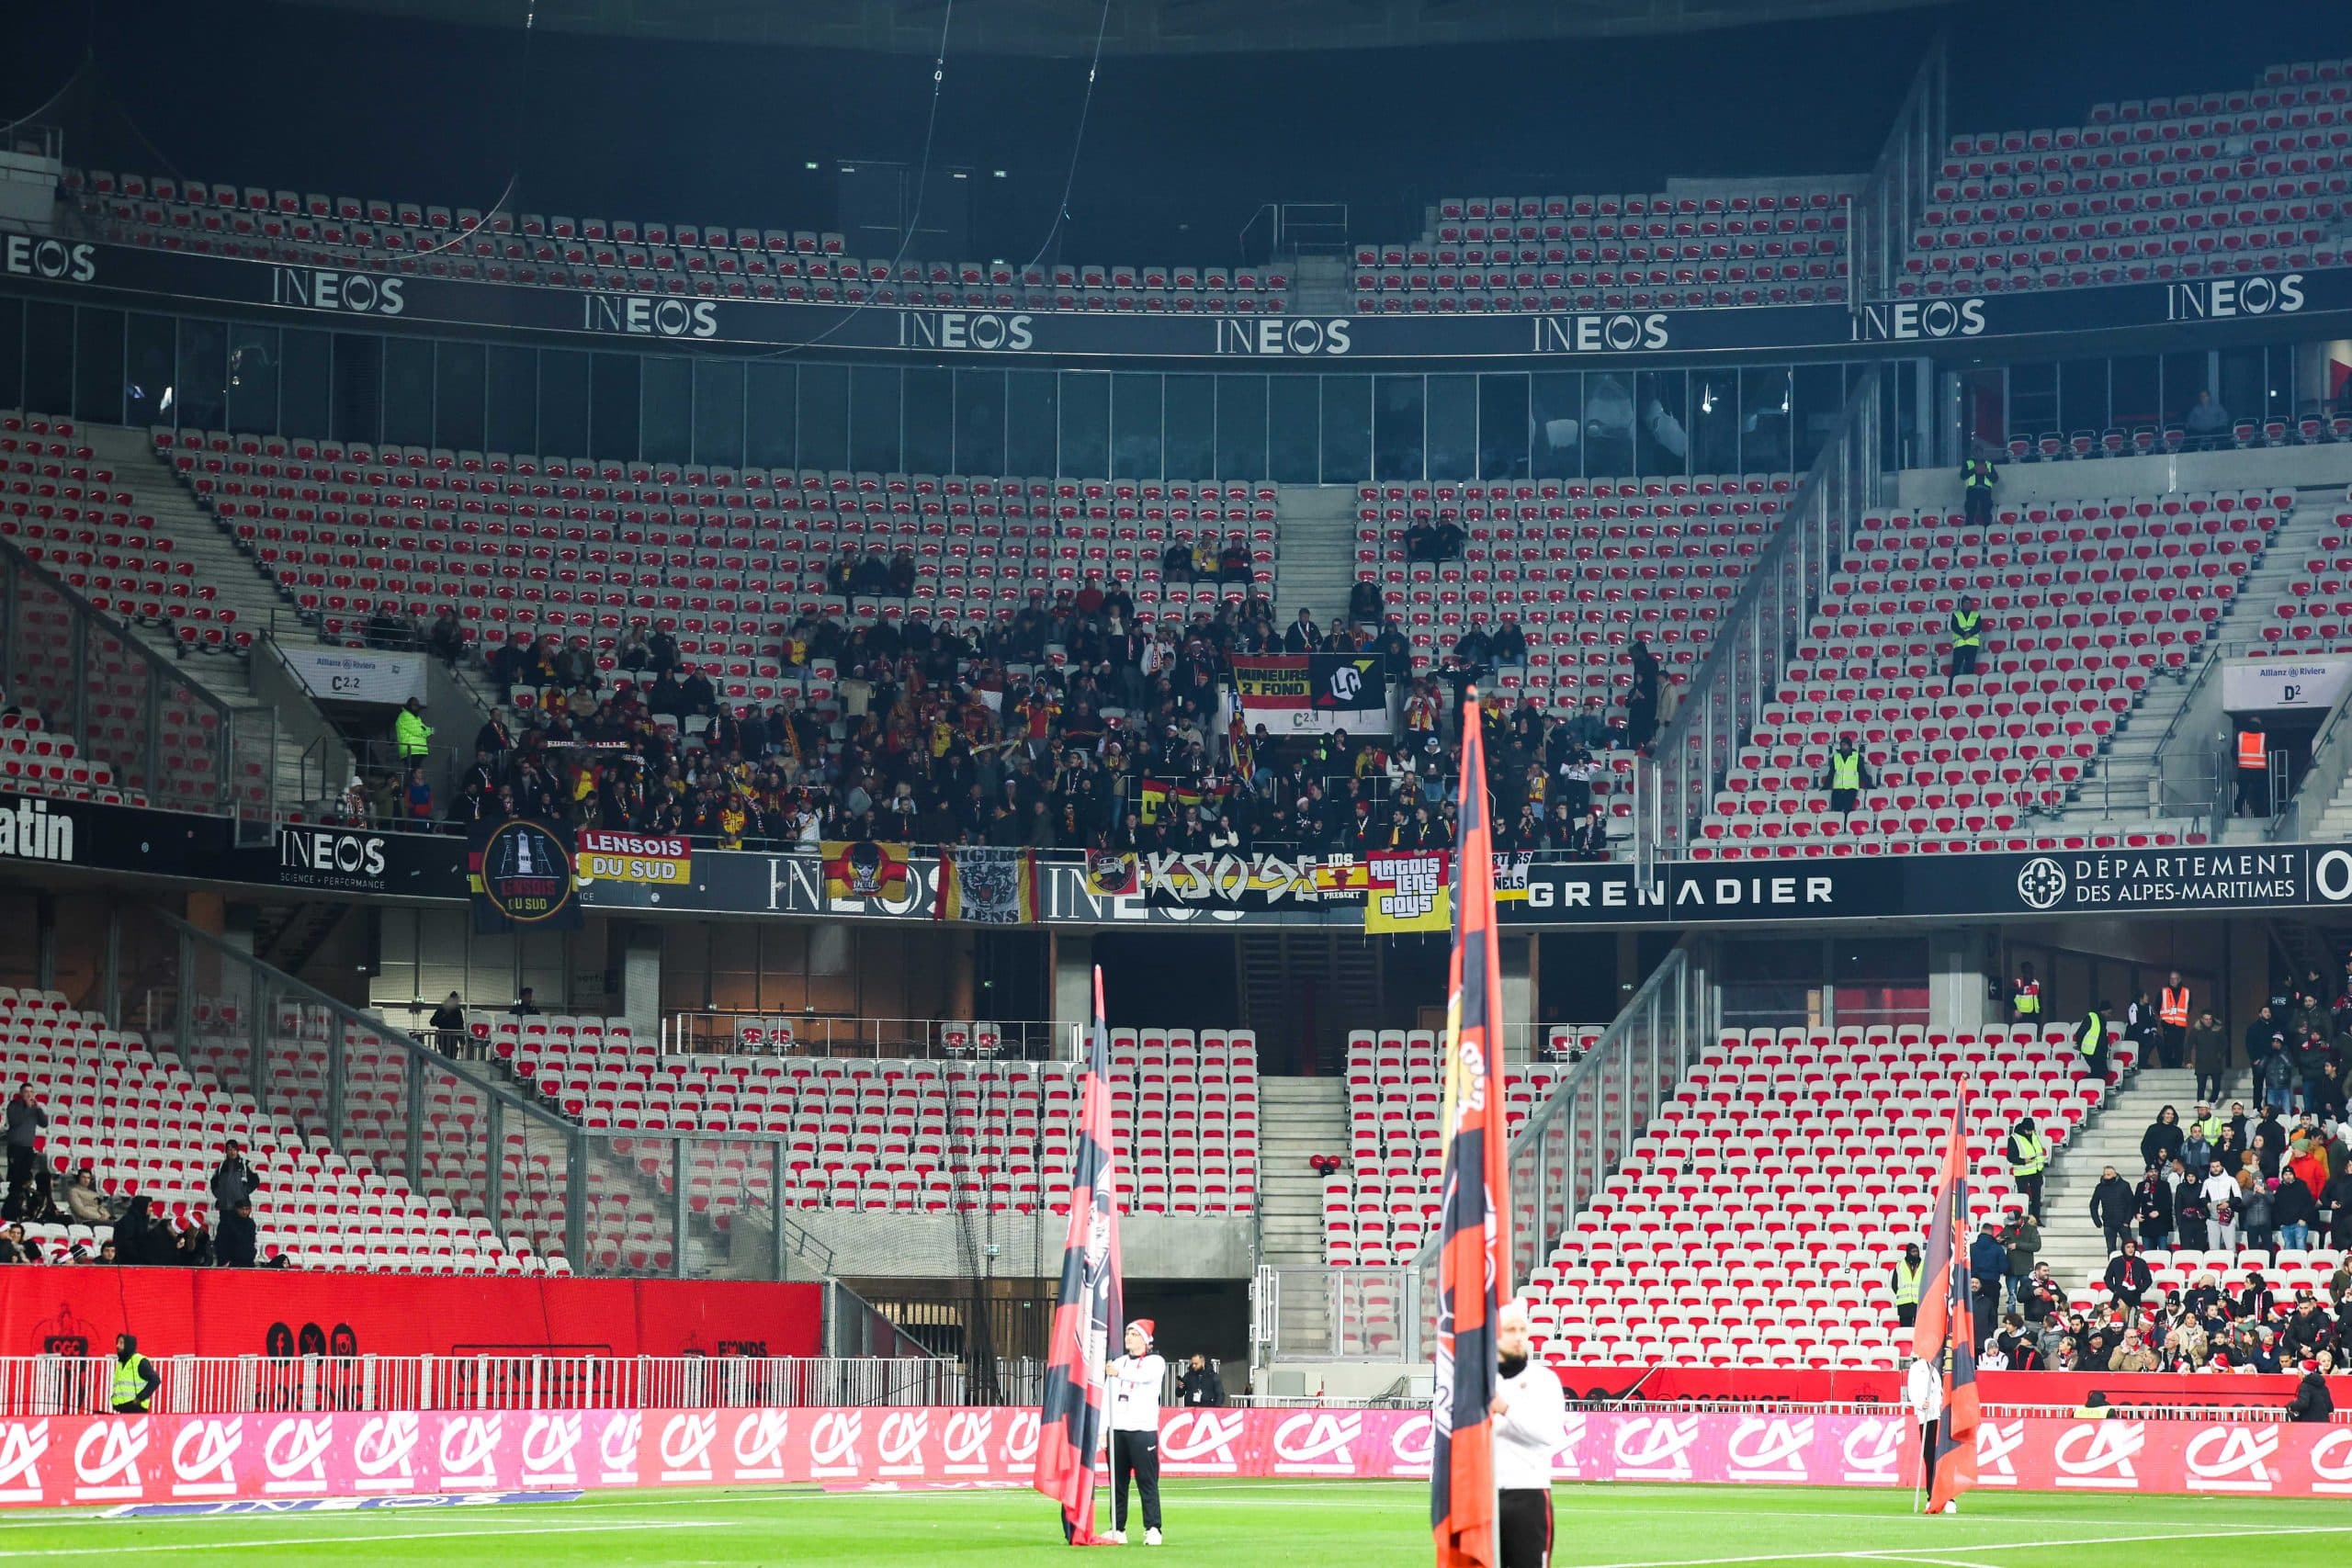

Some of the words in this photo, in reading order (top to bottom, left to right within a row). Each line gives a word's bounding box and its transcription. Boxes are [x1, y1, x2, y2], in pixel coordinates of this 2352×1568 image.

[272, 266, 405, 315] INEOS
[2166, 275, 2304, 321] INEOS
[583, 294, 718, 337] INEOS
[1850, 299, 1985, 342] INEOS
[898, 311, 1033, 351] INEOS
[1215, 318, 1351, 355] INEOS
[1533, 314, 1669, 352] INEOS
[354, 661, 376, 670] Riviera
[1238, 668, 1308, 682] MINEURS
[2260, 669, 2287, 677] Allianz
[2300, 667, 2325, 676] Riviera
[1261, 682, 1305, 695] FOND
[280, 830, 385, 874] INEOS
[586, 833, 683, 856] LENSOIS
[593, 856, 623, 876] DU
[631, 860, 676, 880] SUD
[1328, 853, 1353, 867] IDS
[2075, 854, 2295, 880] DÉPARTEMENT
[280, 873, 314, 884] SCIENCE
[324, 876, 385, 889] PERFORMANCE
[1528, 877, 1832, 907] GRENADIER
[2076, 885, 2110, 902] DES
[2118, 880, 2295, 901] ALPES-MARITIMES
[525, 897, 548, 910] SUD
[1324, 891, 1360, 900] PRESENT
[960, 907, 1019, 924] LENS
